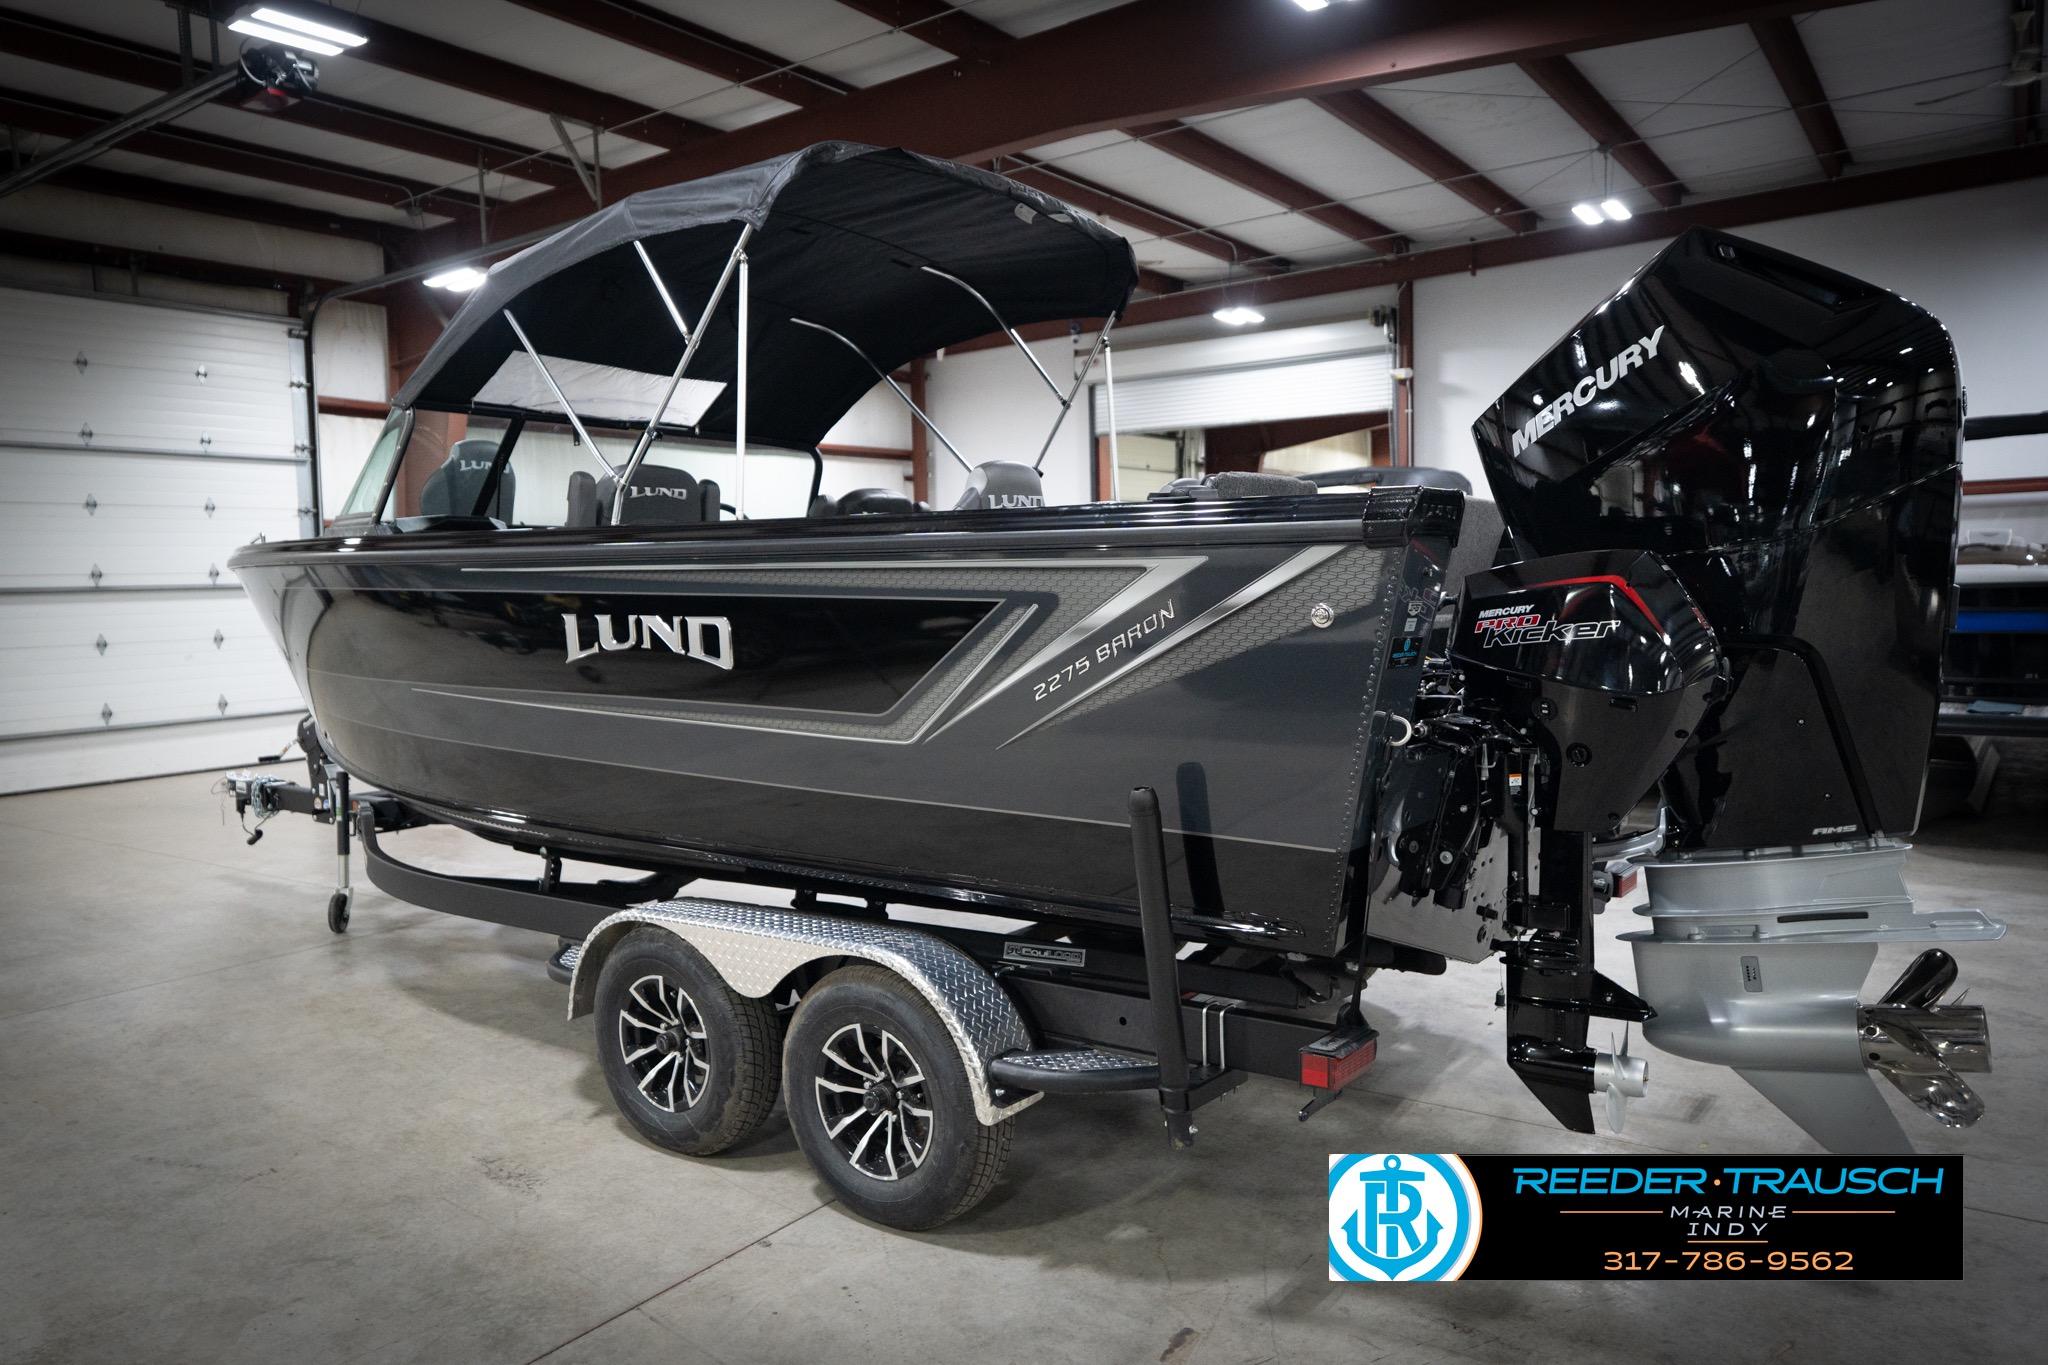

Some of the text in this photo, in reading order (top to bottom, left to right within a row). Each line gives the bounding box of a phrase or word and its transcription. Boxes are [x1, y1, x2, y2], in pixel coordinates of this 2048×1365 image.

[1512, 324, 1665, 458] MERCURY
[630, 485, 687, 500] LUND
[1478, 604, 1535, 619] MERCURY
[1474, 614, 1541, 633] PRO
[561, 613, 734, 670] LUND
[1033, 599, 1176, 701] 2275 BARON
[1812, 824, 1857, 836] AMS
